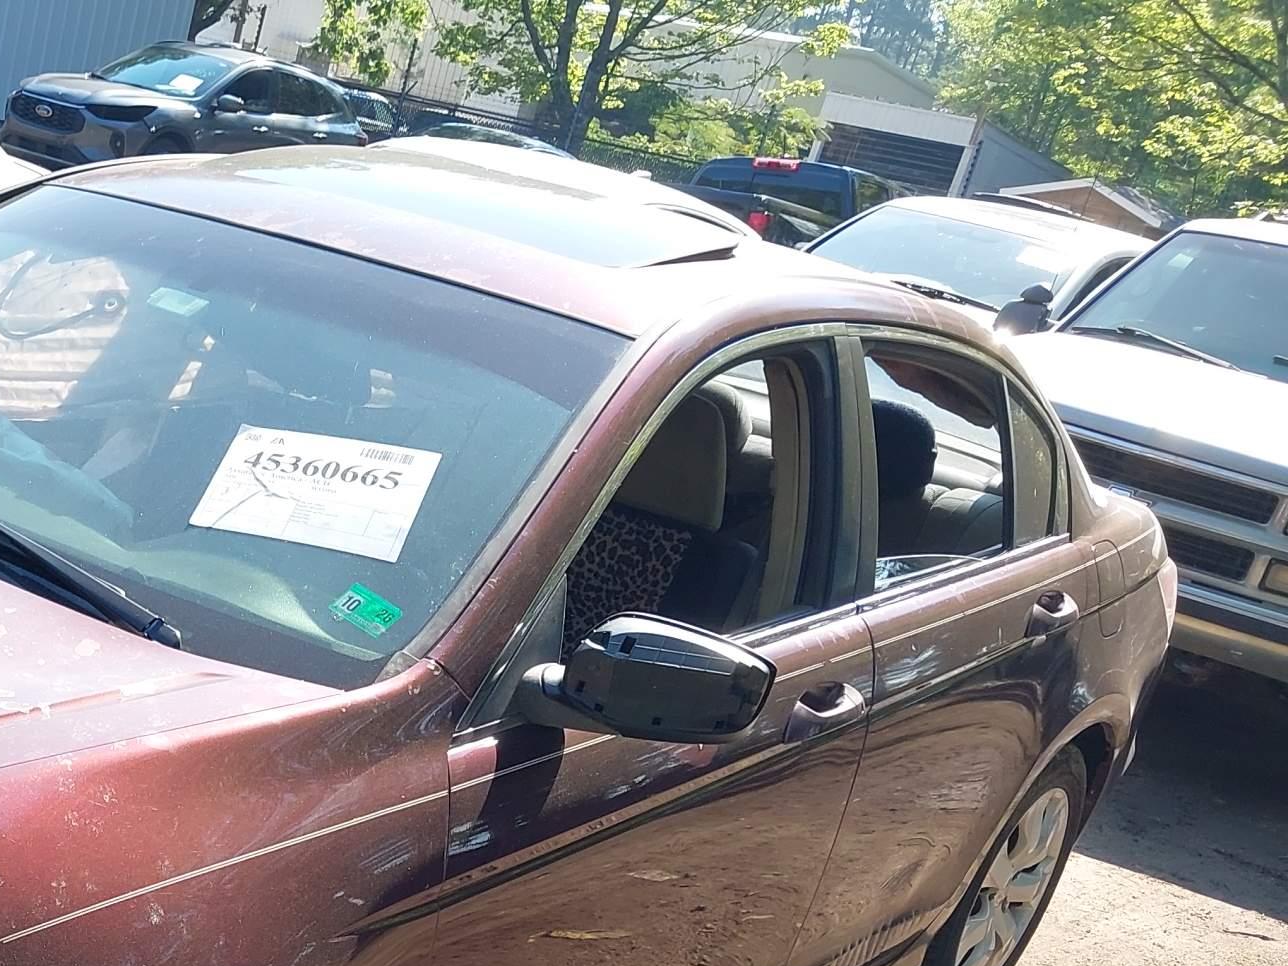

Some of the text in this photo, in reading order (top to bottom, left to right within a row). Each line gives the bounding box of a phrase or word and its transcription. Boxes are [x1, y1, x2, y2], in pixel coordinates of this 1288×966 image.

[243, 450, 404, 490] 45360665
[341, 595, 362, 612] 10
[375, 609, 396, 623] 26
